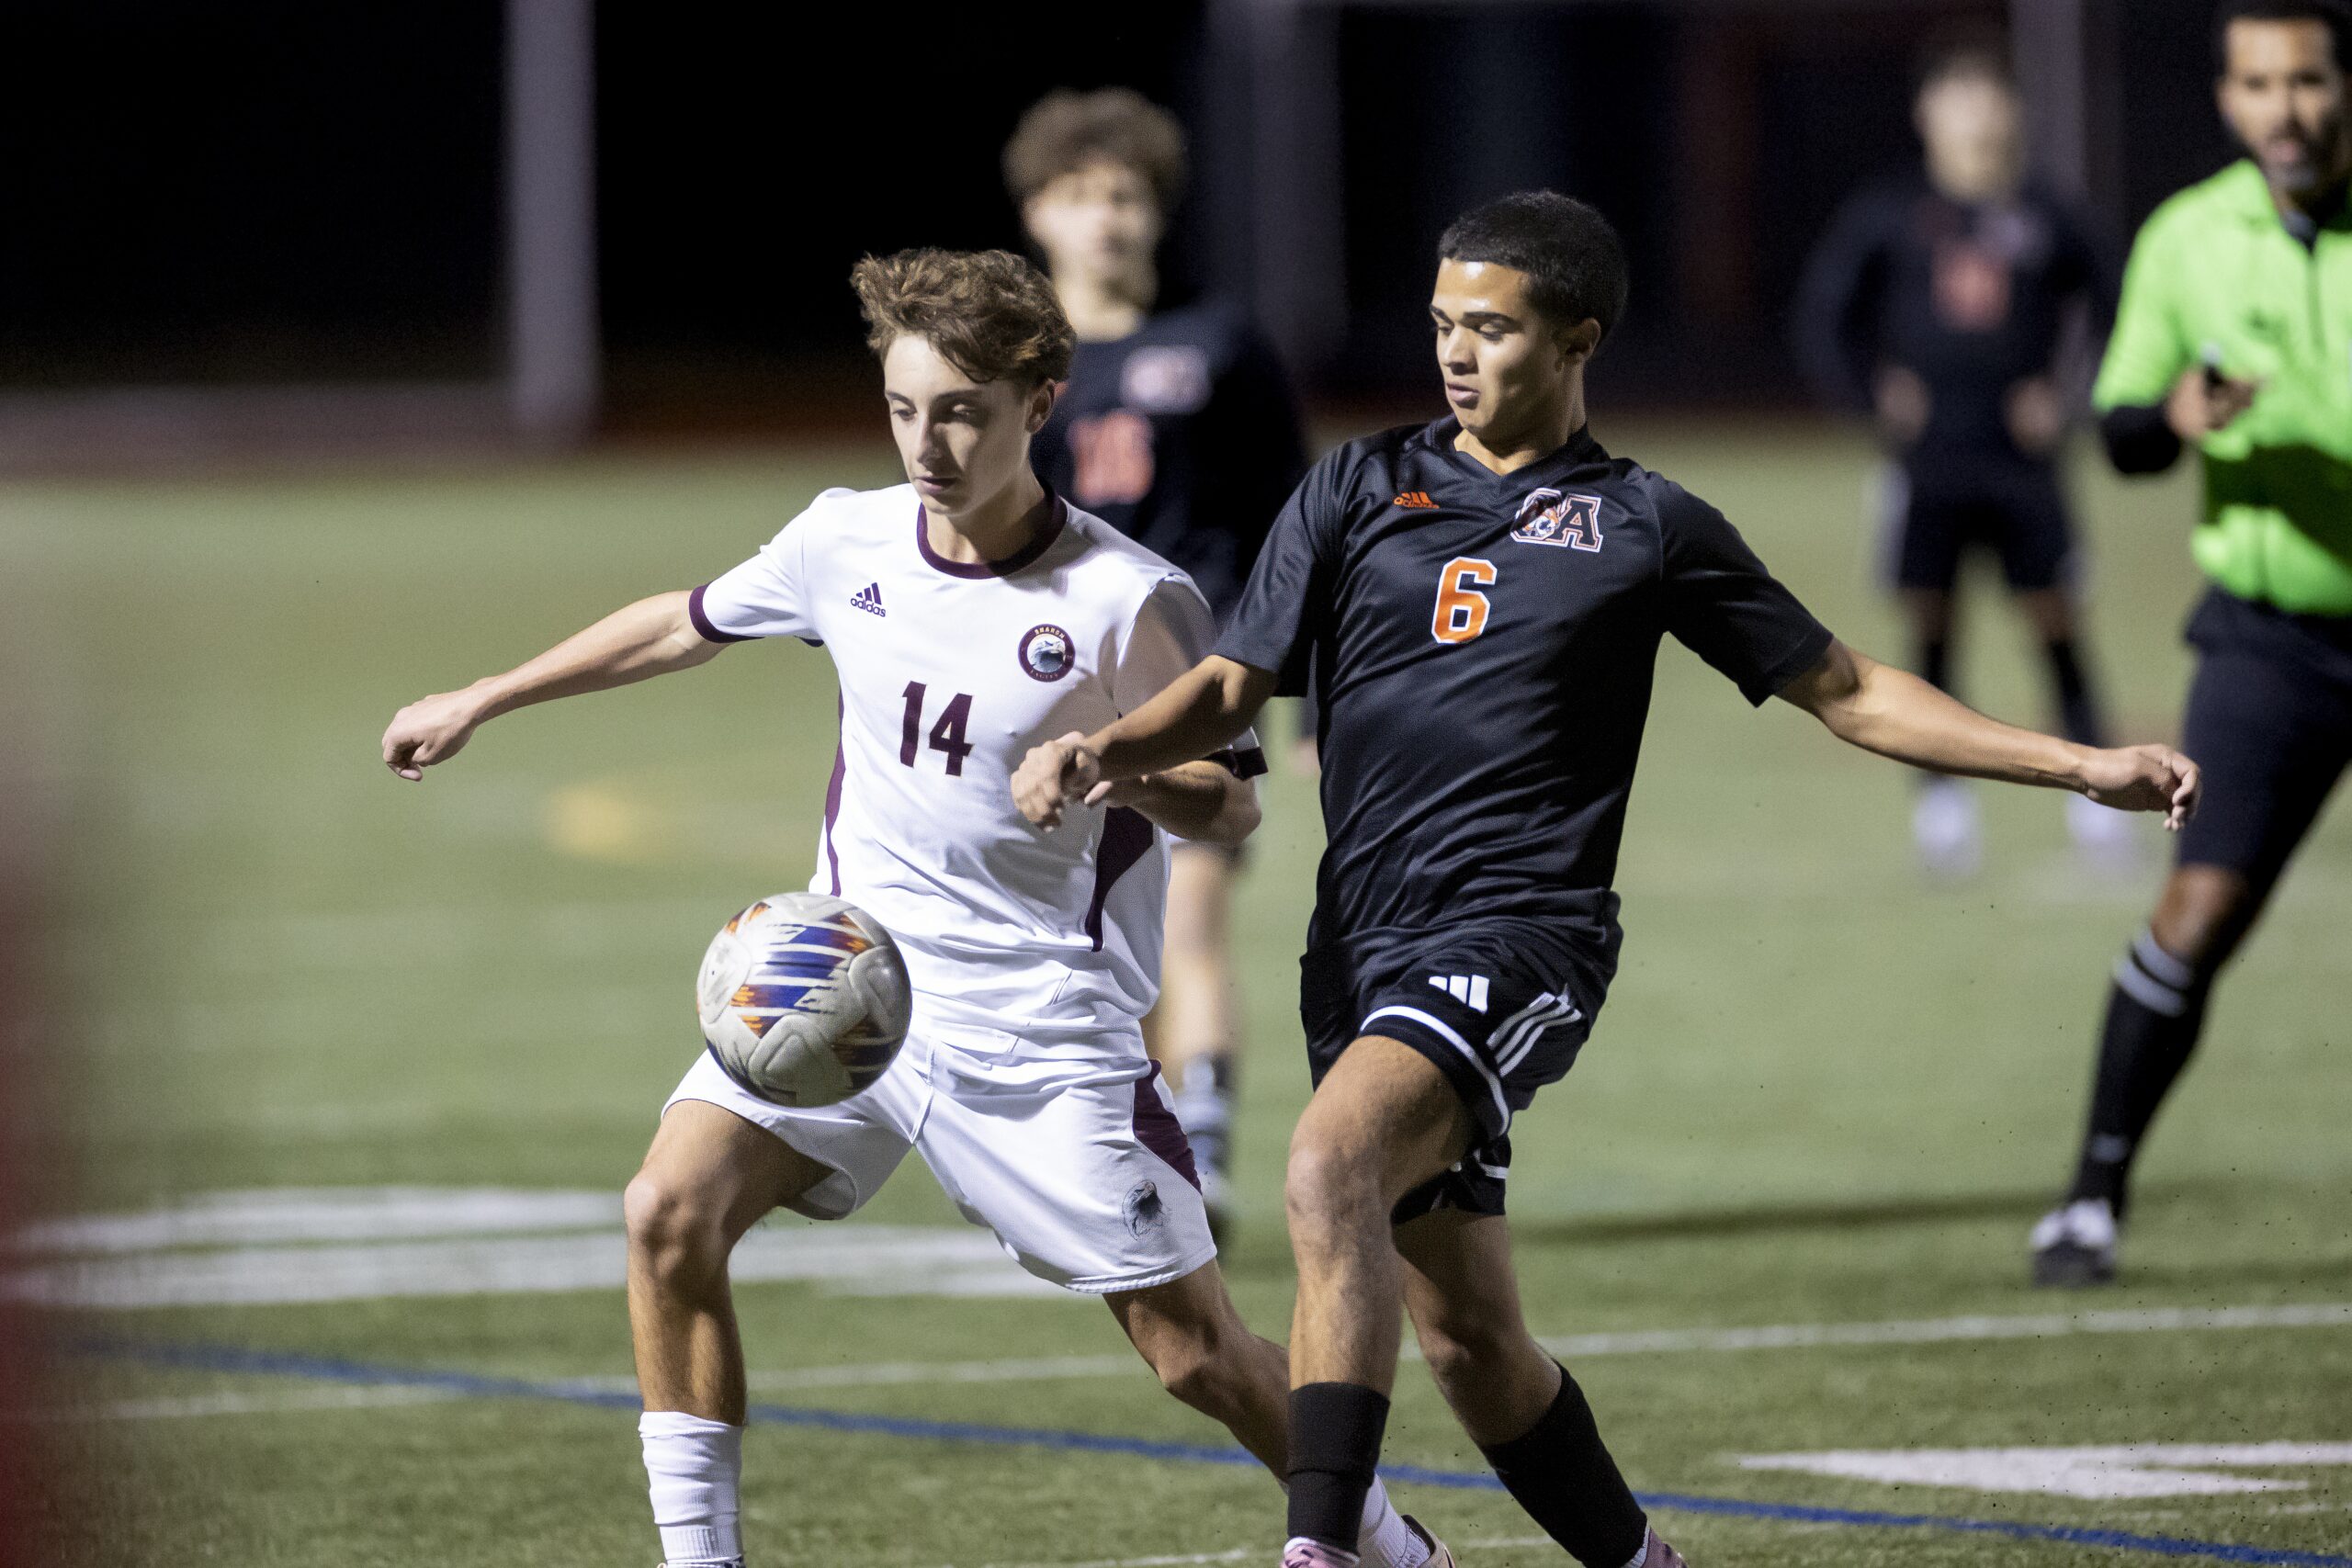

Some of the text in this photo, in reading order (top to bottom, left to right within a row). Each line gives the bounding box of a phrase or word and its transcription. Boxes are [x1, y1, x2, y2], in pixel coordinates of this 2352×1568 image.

[851, 598, 886, 618] adidas
[1431, 556, 1498, 644] 6
[899, 680, 975, 777] 14
